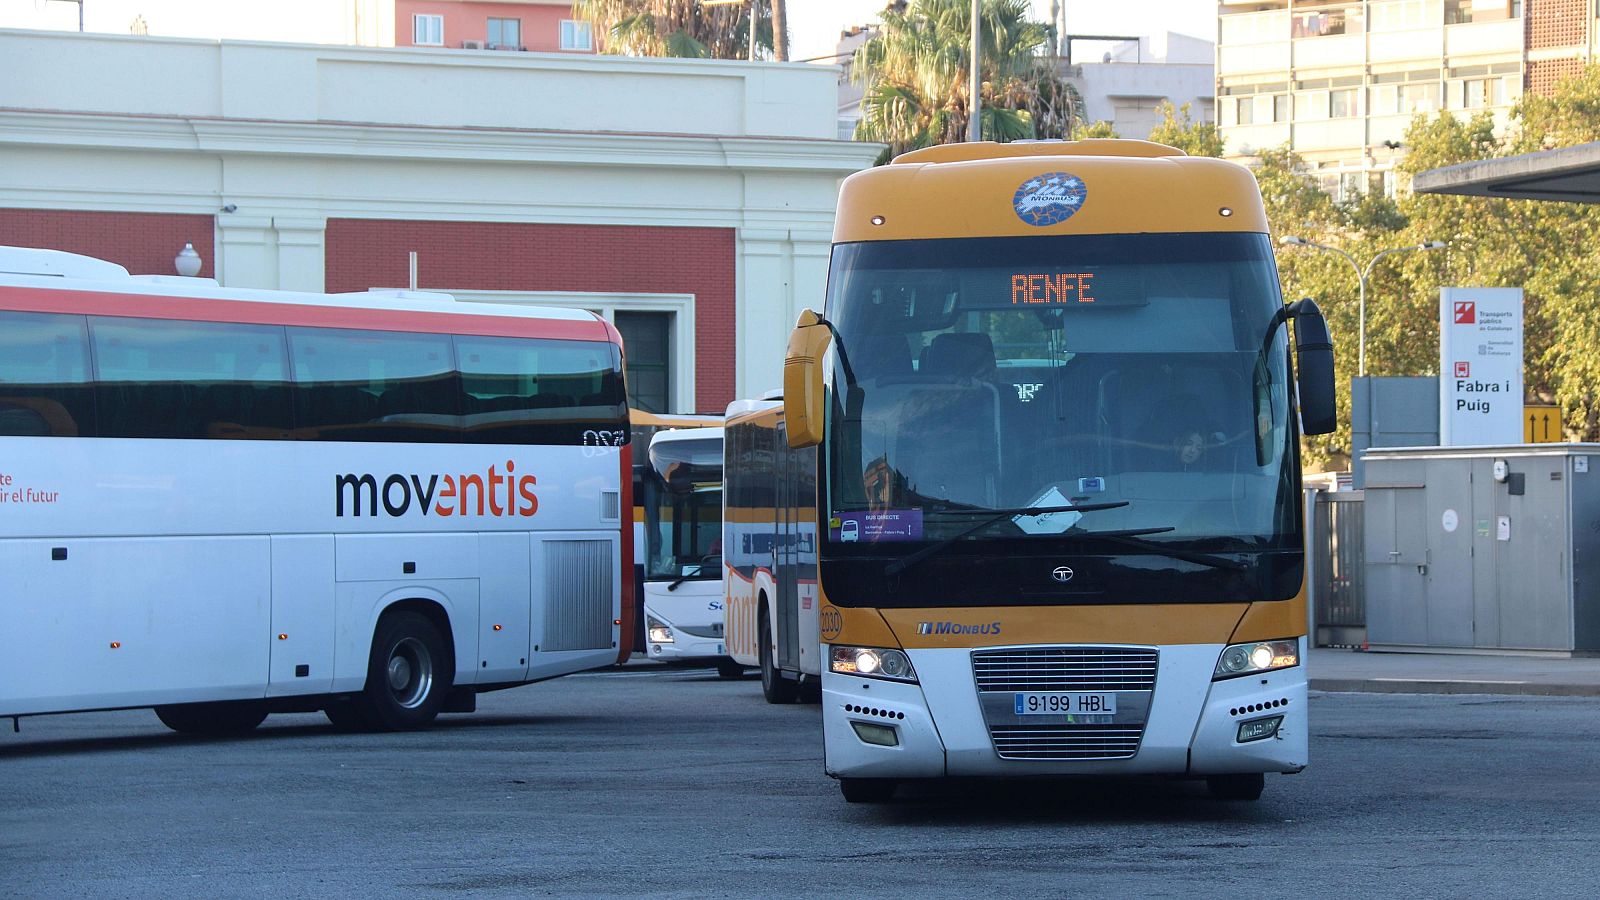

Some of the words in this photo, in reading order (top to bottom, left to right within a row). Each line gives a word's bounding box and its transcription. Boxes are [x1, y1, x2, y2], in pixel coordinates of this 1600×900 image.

[1011, 273, 1095, 304] RENFE
[1456, 380, 1500, 393] Fabra
[1505, 380, 1510, 393] i
[1456, 399, 1491, 414] Puig
[12, 487, 24, 503] el
[27, 487, 59, 503] futur
[335, 459, 539, 518] moventis
[820, 611, 840, 633] 2030
[934, 621, 1001, 636] MONBUS
[1078, 695, 1112, 712] HBL
